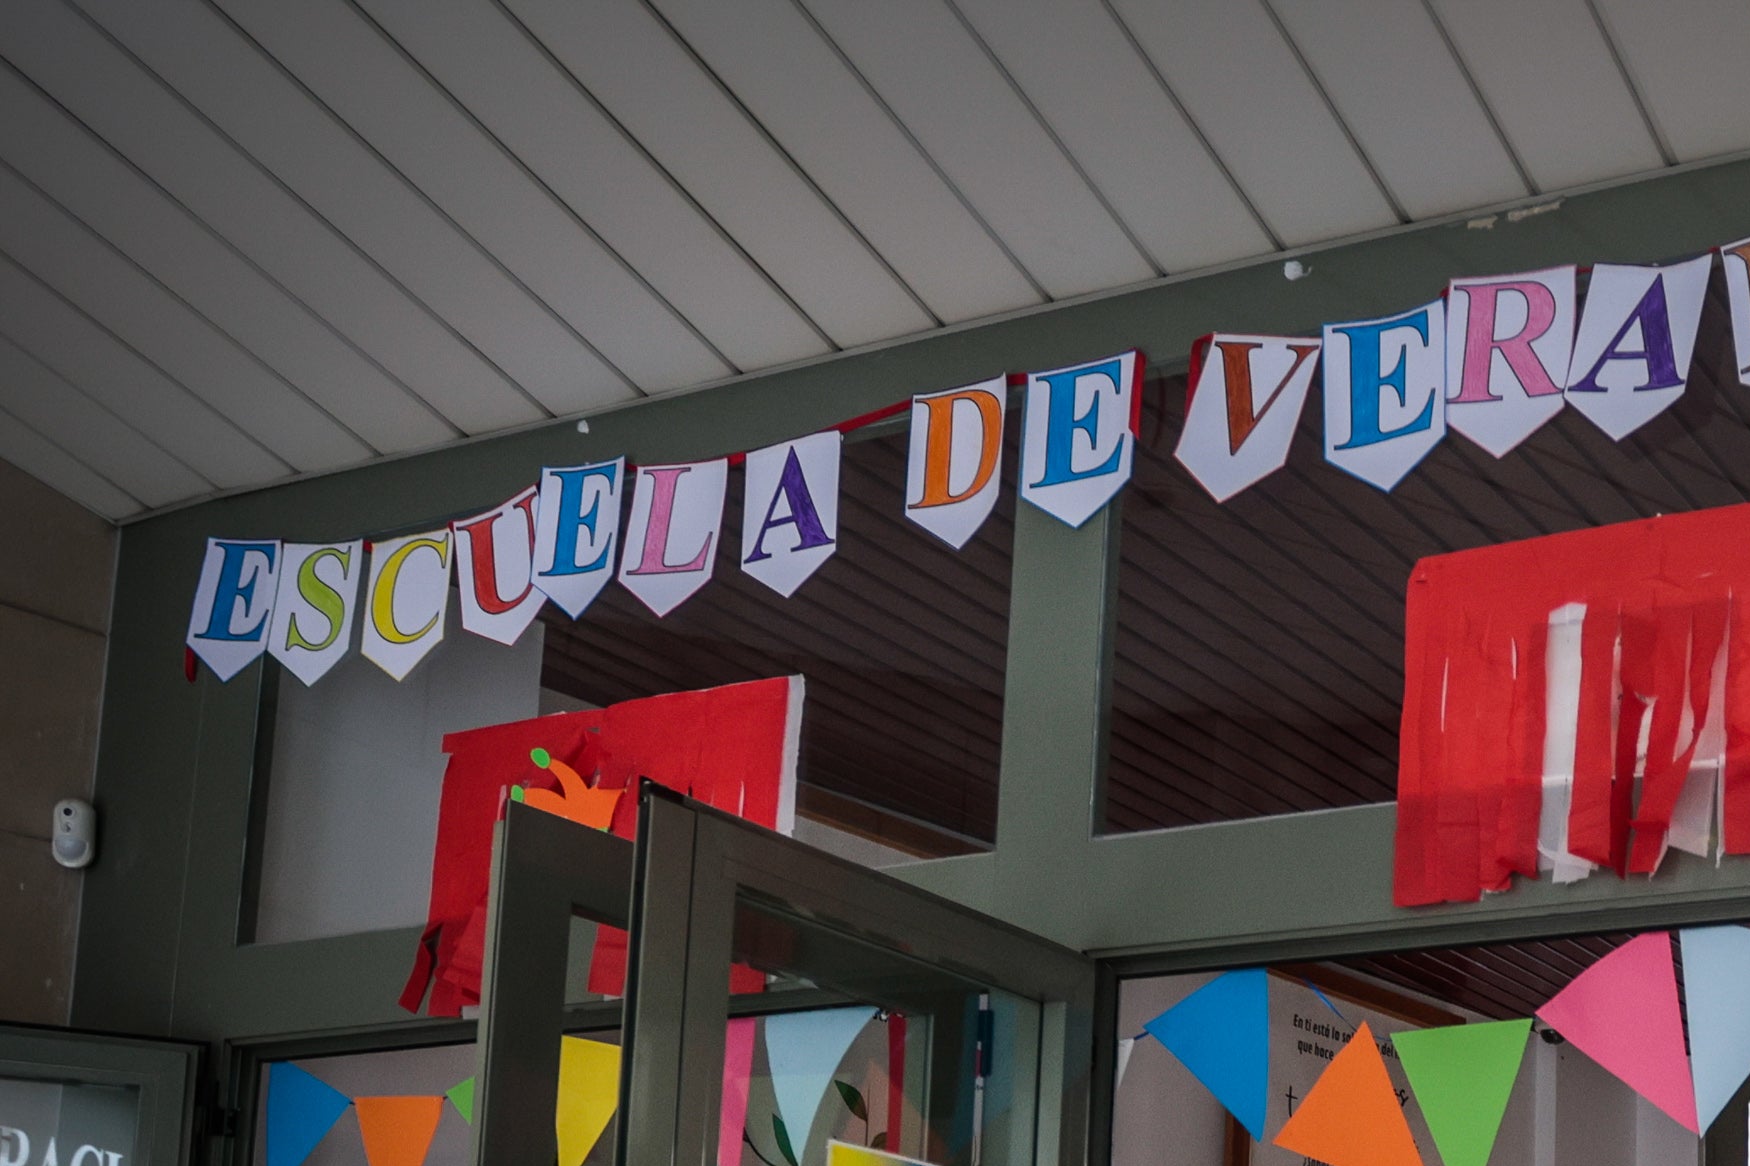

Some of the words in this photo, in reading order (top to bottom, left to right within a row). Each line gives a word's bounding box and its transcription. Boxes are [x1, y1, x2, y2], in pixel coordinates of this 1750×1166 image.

[193, 445, 834, 652] ESCUELA
[907, 358, 1134, 511] DE
[1293, 1013, 1304, 1029] En
[1305, 1018, 1312, 1032] ti
[1313, 1023, 1330, 1038] está
[1332, 1027, 1341, 1041] la
[1298, 1040, 1313, 1055] que
[1314, 1042, 1334, 1061] hace
